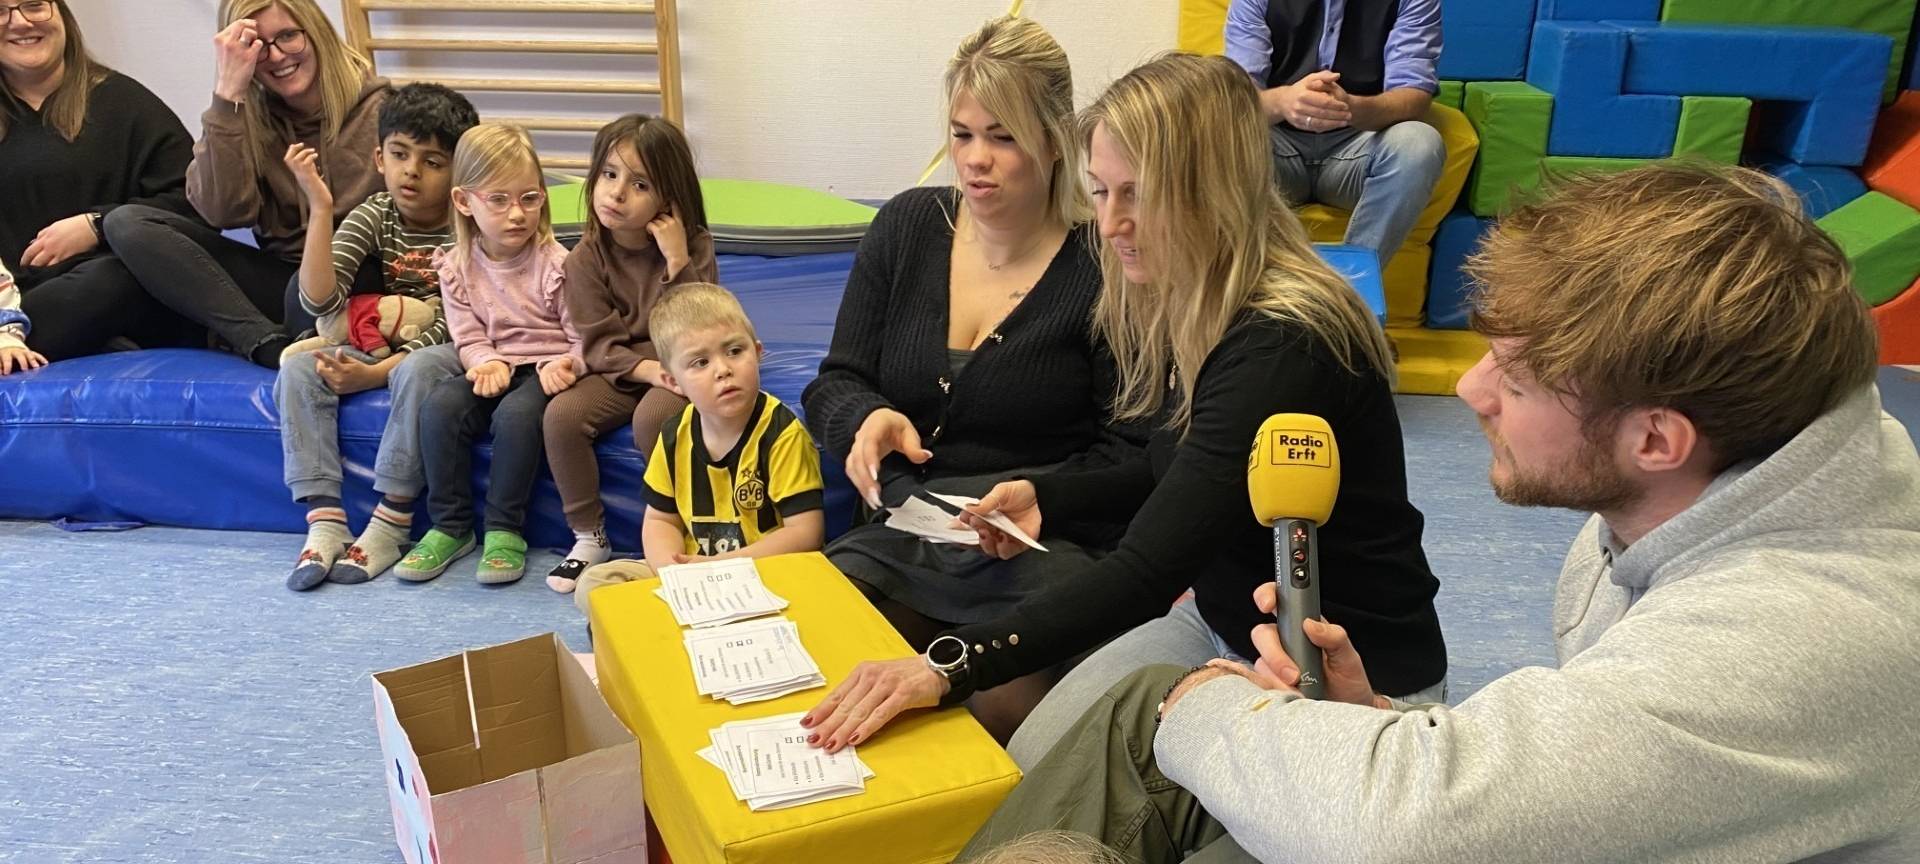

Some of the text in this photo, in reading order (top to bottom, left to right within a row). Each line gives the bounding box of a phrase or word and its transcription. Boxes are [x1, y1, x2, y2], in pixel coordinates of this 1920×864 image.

[1279, 434, 1323, 448] Radio
[1288, 448, 1316, 460] Erft
[740, 482, 762, 501] BVB
